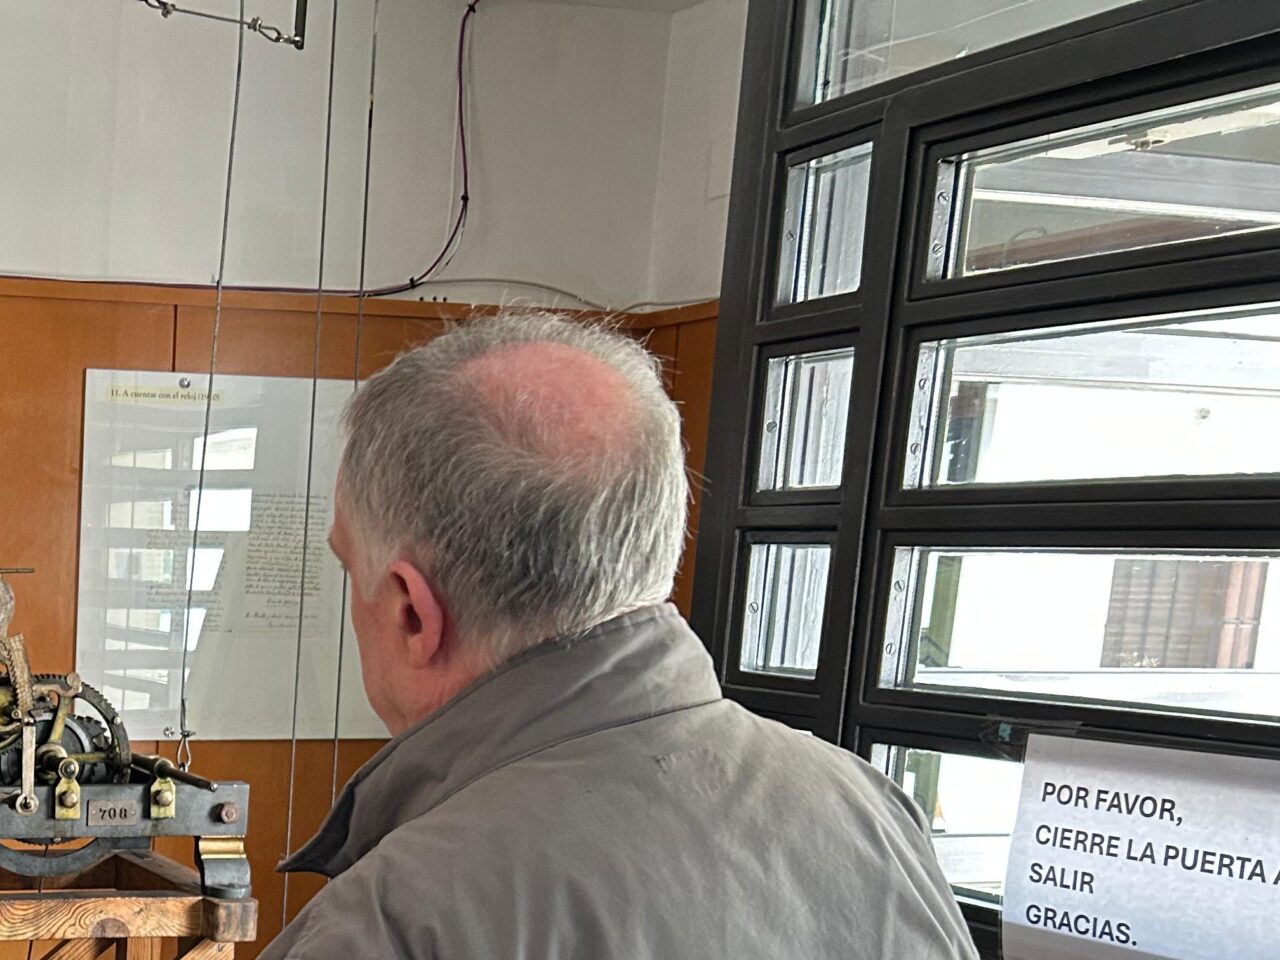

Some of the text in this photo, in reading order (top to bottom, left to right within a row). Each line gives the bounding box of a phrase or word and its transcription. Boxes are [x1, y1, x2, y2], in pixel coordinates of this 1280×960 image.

[180, 392, 196, 401] reloj
[1041, 782, 1183, 826] POR FAVOR,
[1035, 824, 1120, 858] CIERRE
[1125, 838, 1156, 865] LA
[1163, 844, 1267, 884] PUERTA
[1028, 862, 1095, 894] SALIR
[1025, 904, 1137, 946] GRACIAS.
